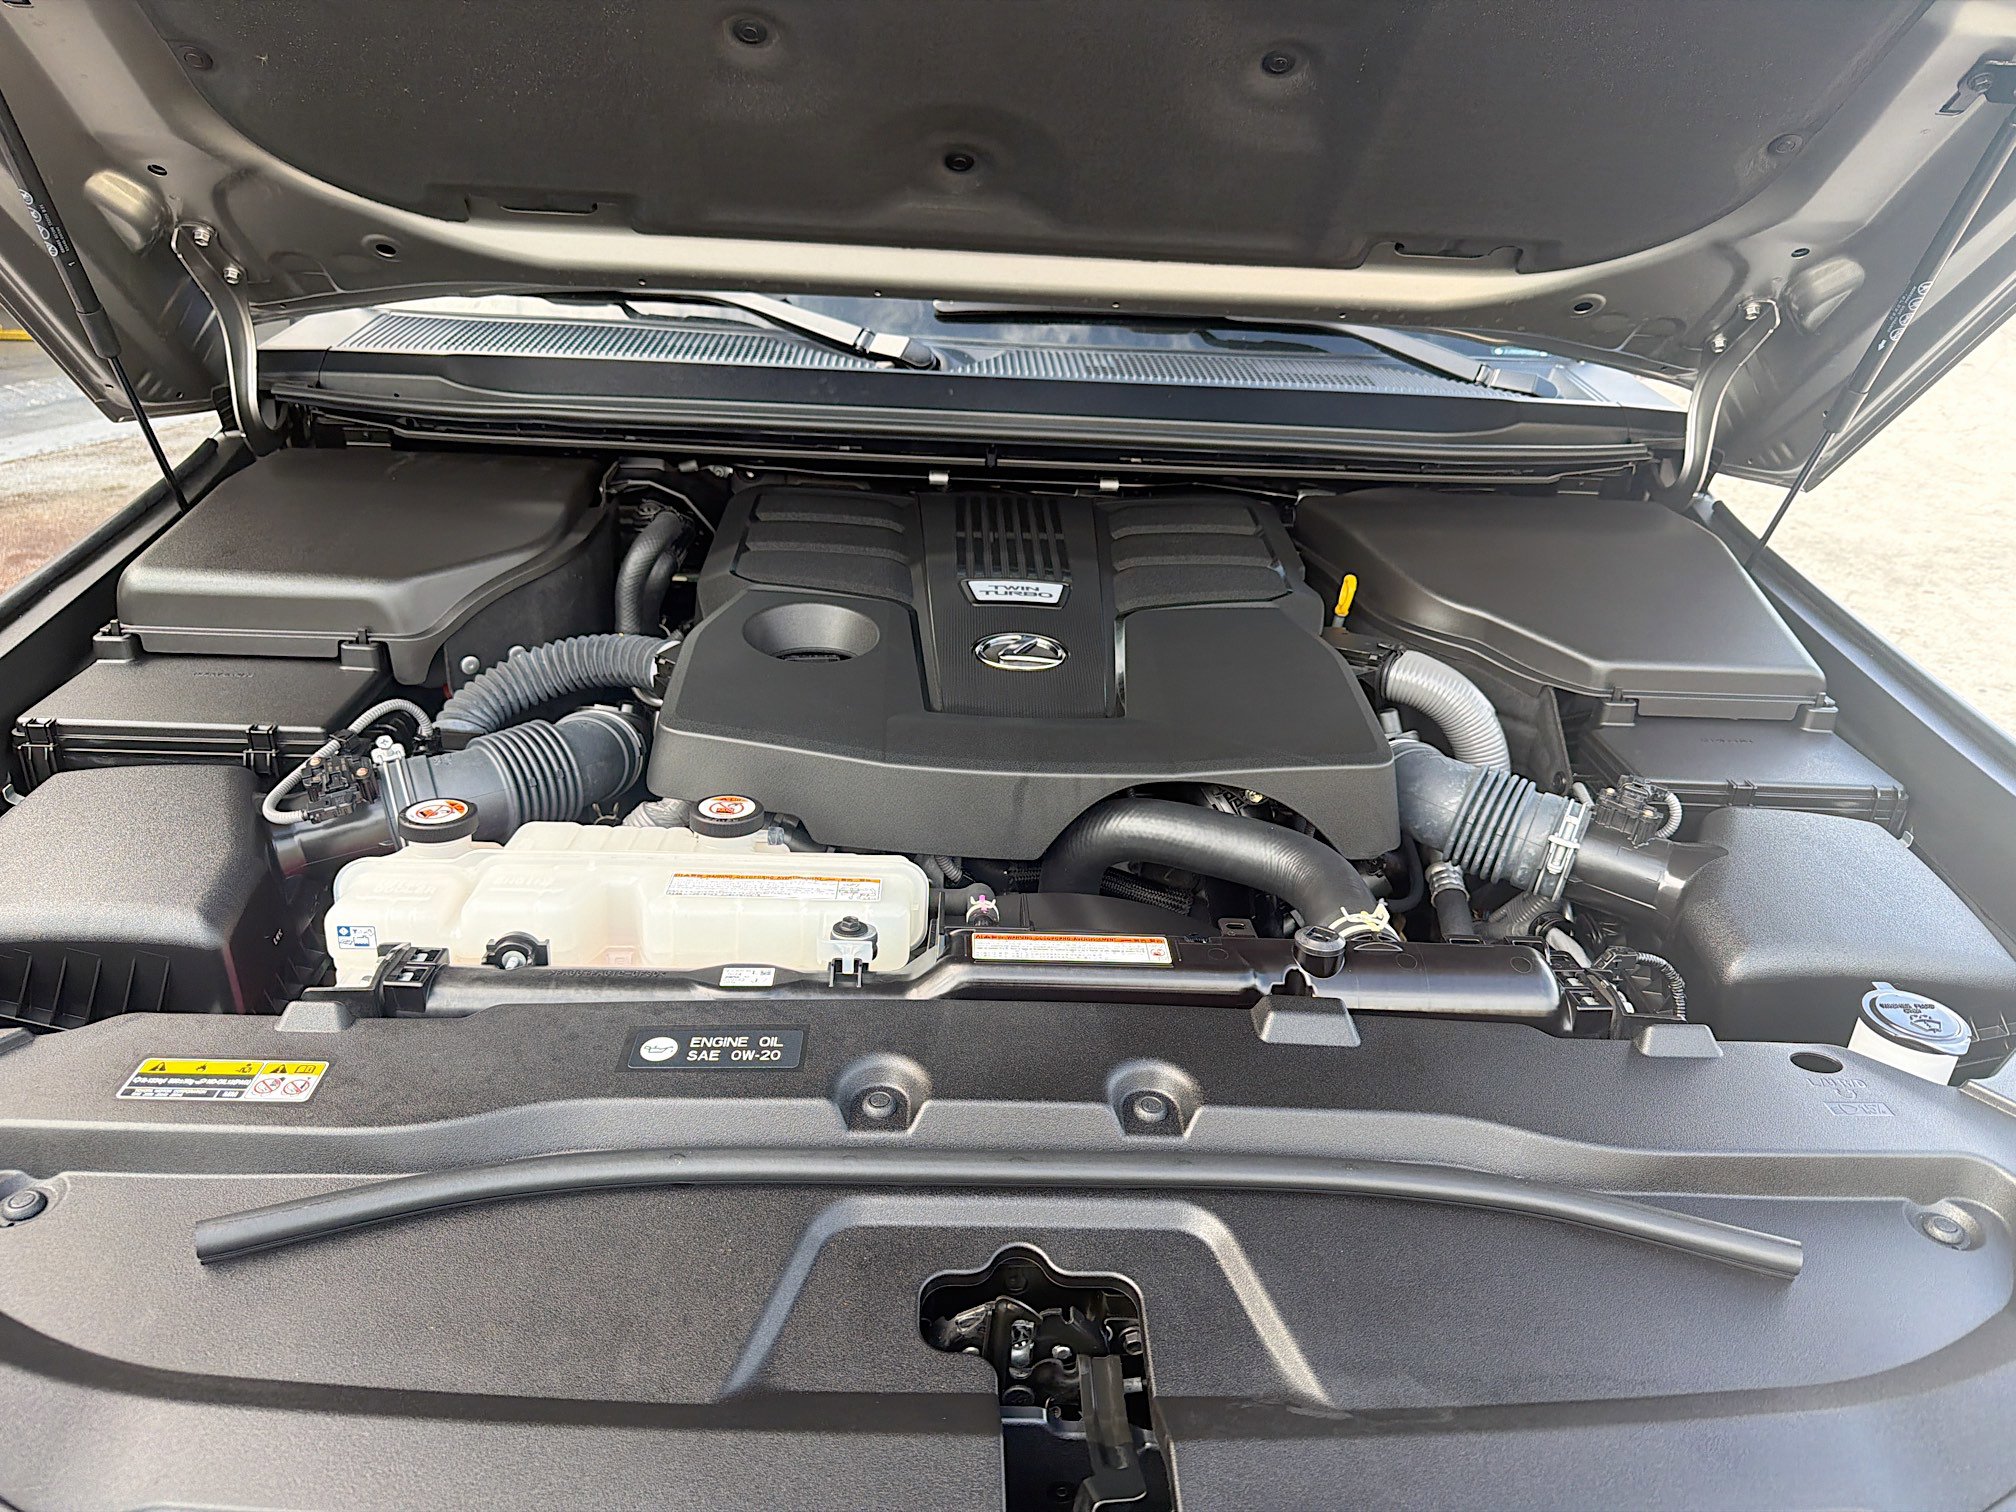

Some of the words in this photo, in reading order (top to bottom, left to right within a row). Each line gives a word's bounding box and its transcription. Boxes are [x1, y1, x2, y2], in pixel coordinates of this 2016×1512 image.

[979, 590, 1053, 598] TURBO
[690, 1037, 749, 1047] ENGINE
[759, 1037, 784, 1047] OIL
[686, 1050, 721, 1061] SAE
[731, 1050, 781, 1061] 0W-20
